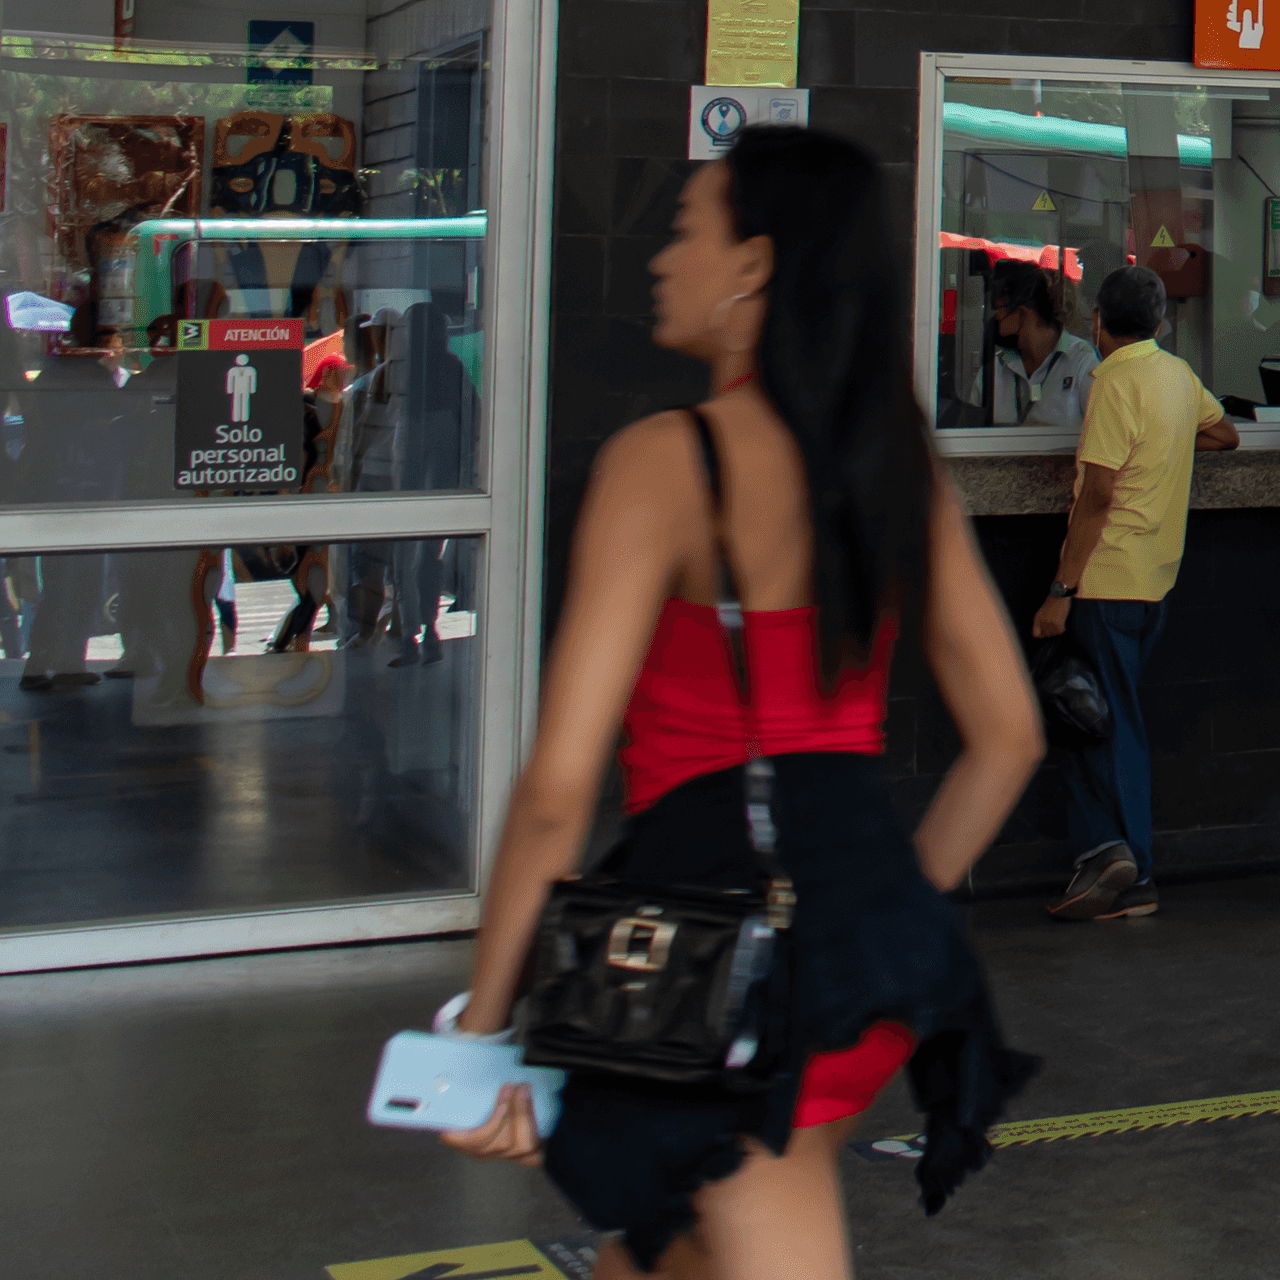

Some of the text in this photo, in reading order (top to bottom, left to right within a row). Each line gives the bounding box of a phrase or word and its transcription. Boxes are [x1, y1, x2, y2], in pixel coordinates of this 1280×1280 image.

[224, 326, 290, 341] ATENCIÓN
[215, 424, 262, 443] Solo
[190, 444, 286, 469] personal
[177, 464, 297, 485] autorizado
